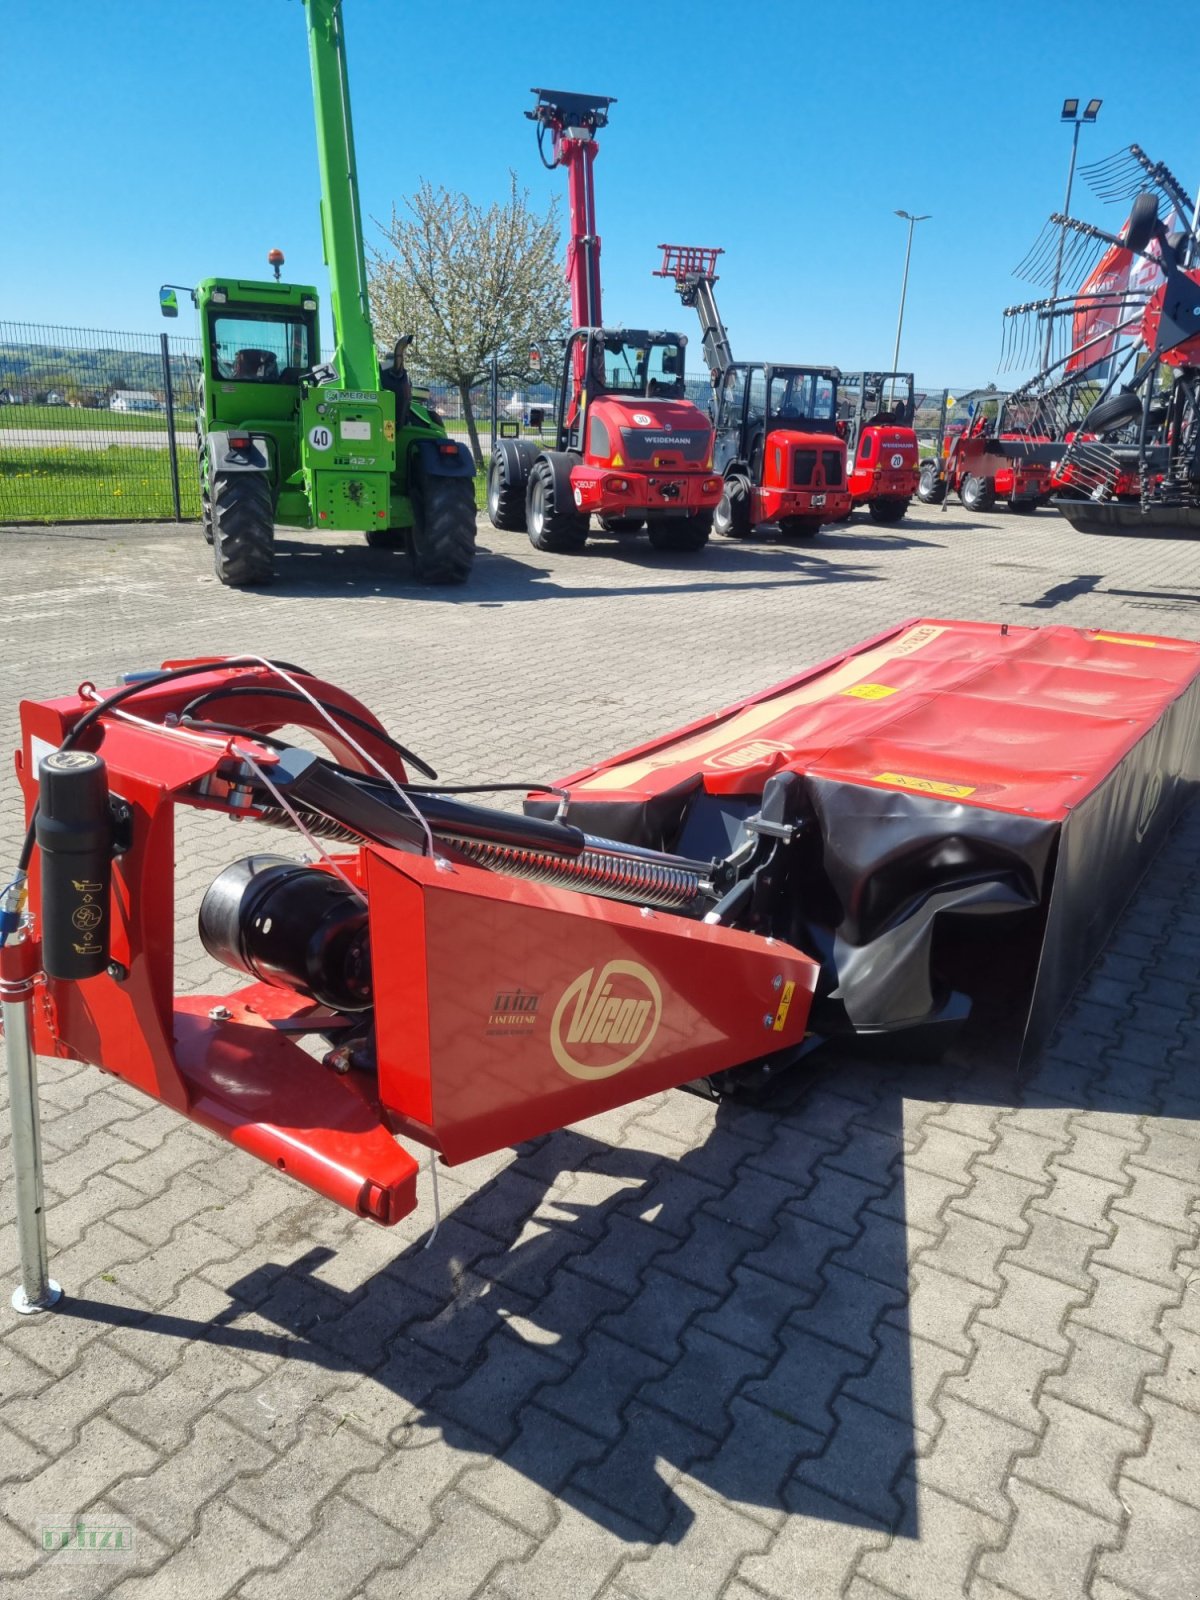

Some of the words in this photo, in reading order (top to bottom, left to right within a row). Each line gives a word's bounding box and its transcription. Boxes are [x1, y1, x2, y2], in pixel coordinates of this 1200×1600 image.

[340, 391, 377, 400] MERLO
[635, 415, 650, 425] 30
[313, 430, 328, 446] 40
[644, 436, 691, 445] WEIDEMANN
[892, 456, 901, 466] 20
[566, 966, 653, 1044] Vicon
